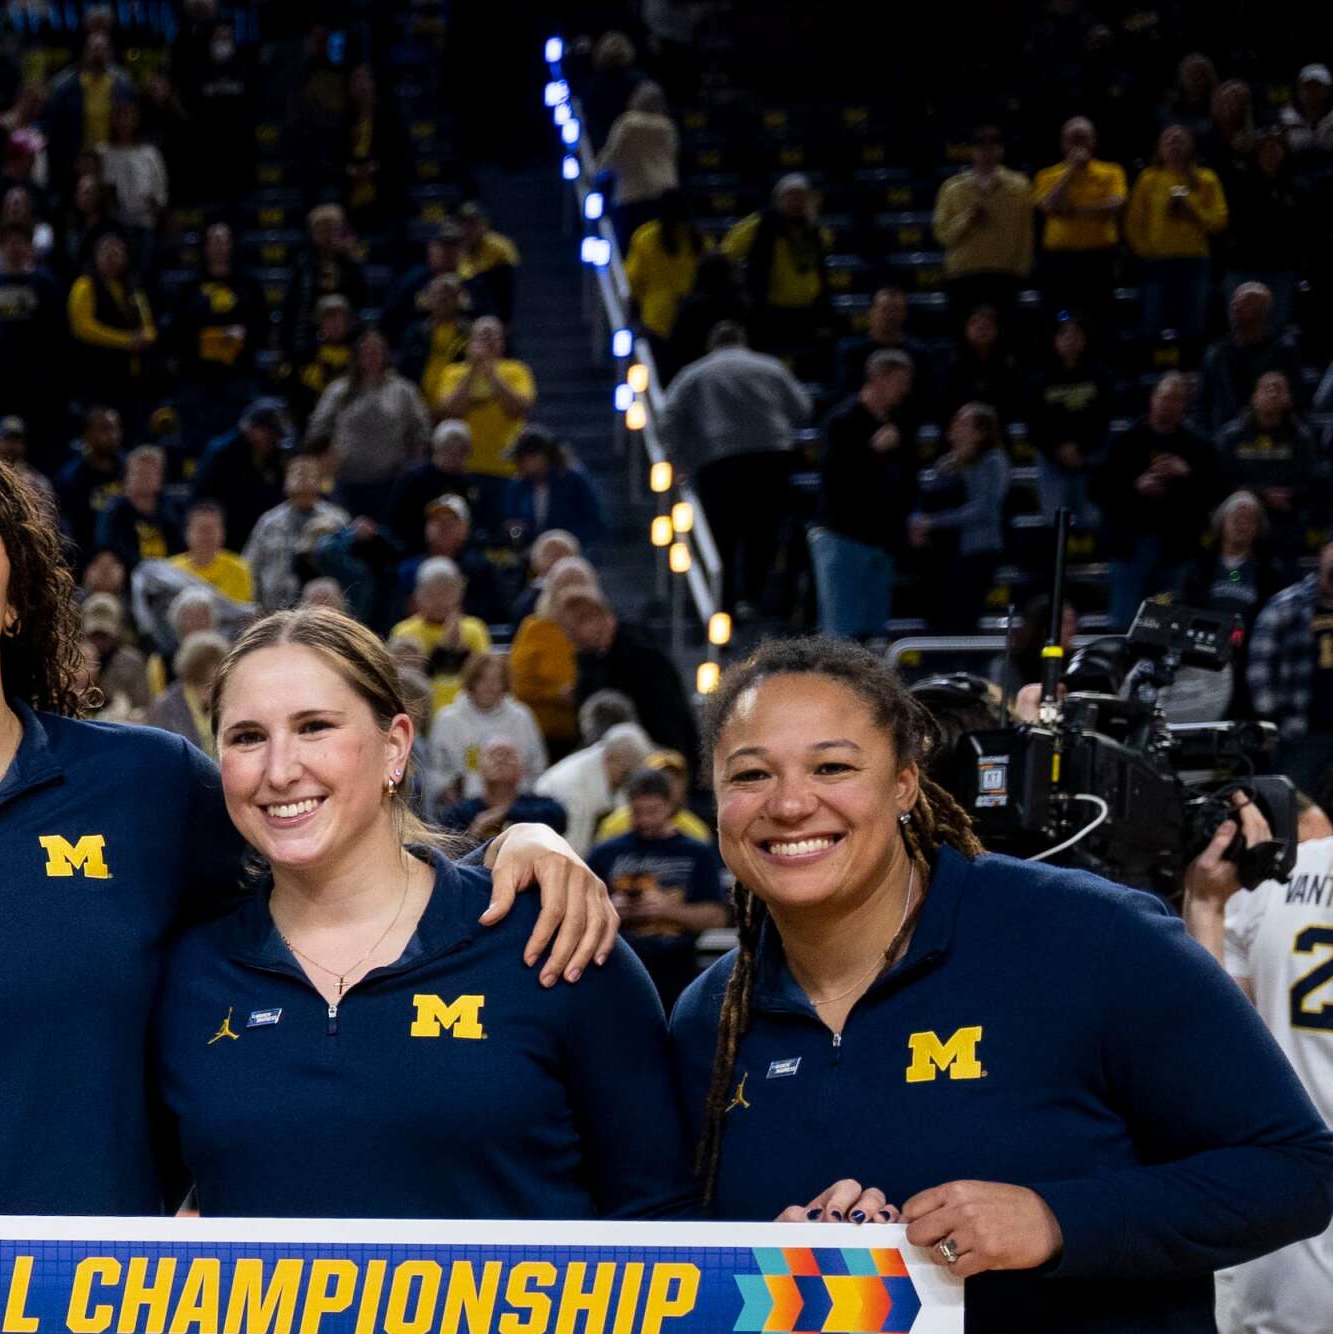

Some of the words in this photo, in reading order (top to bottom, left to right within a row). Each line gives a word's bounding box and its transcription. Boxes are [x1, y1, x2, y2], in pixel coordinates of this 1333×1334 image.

[40, 834, 109, 879] M
[411, 993, 485, 1039] M
[905, 1026, 984, 1083] M
